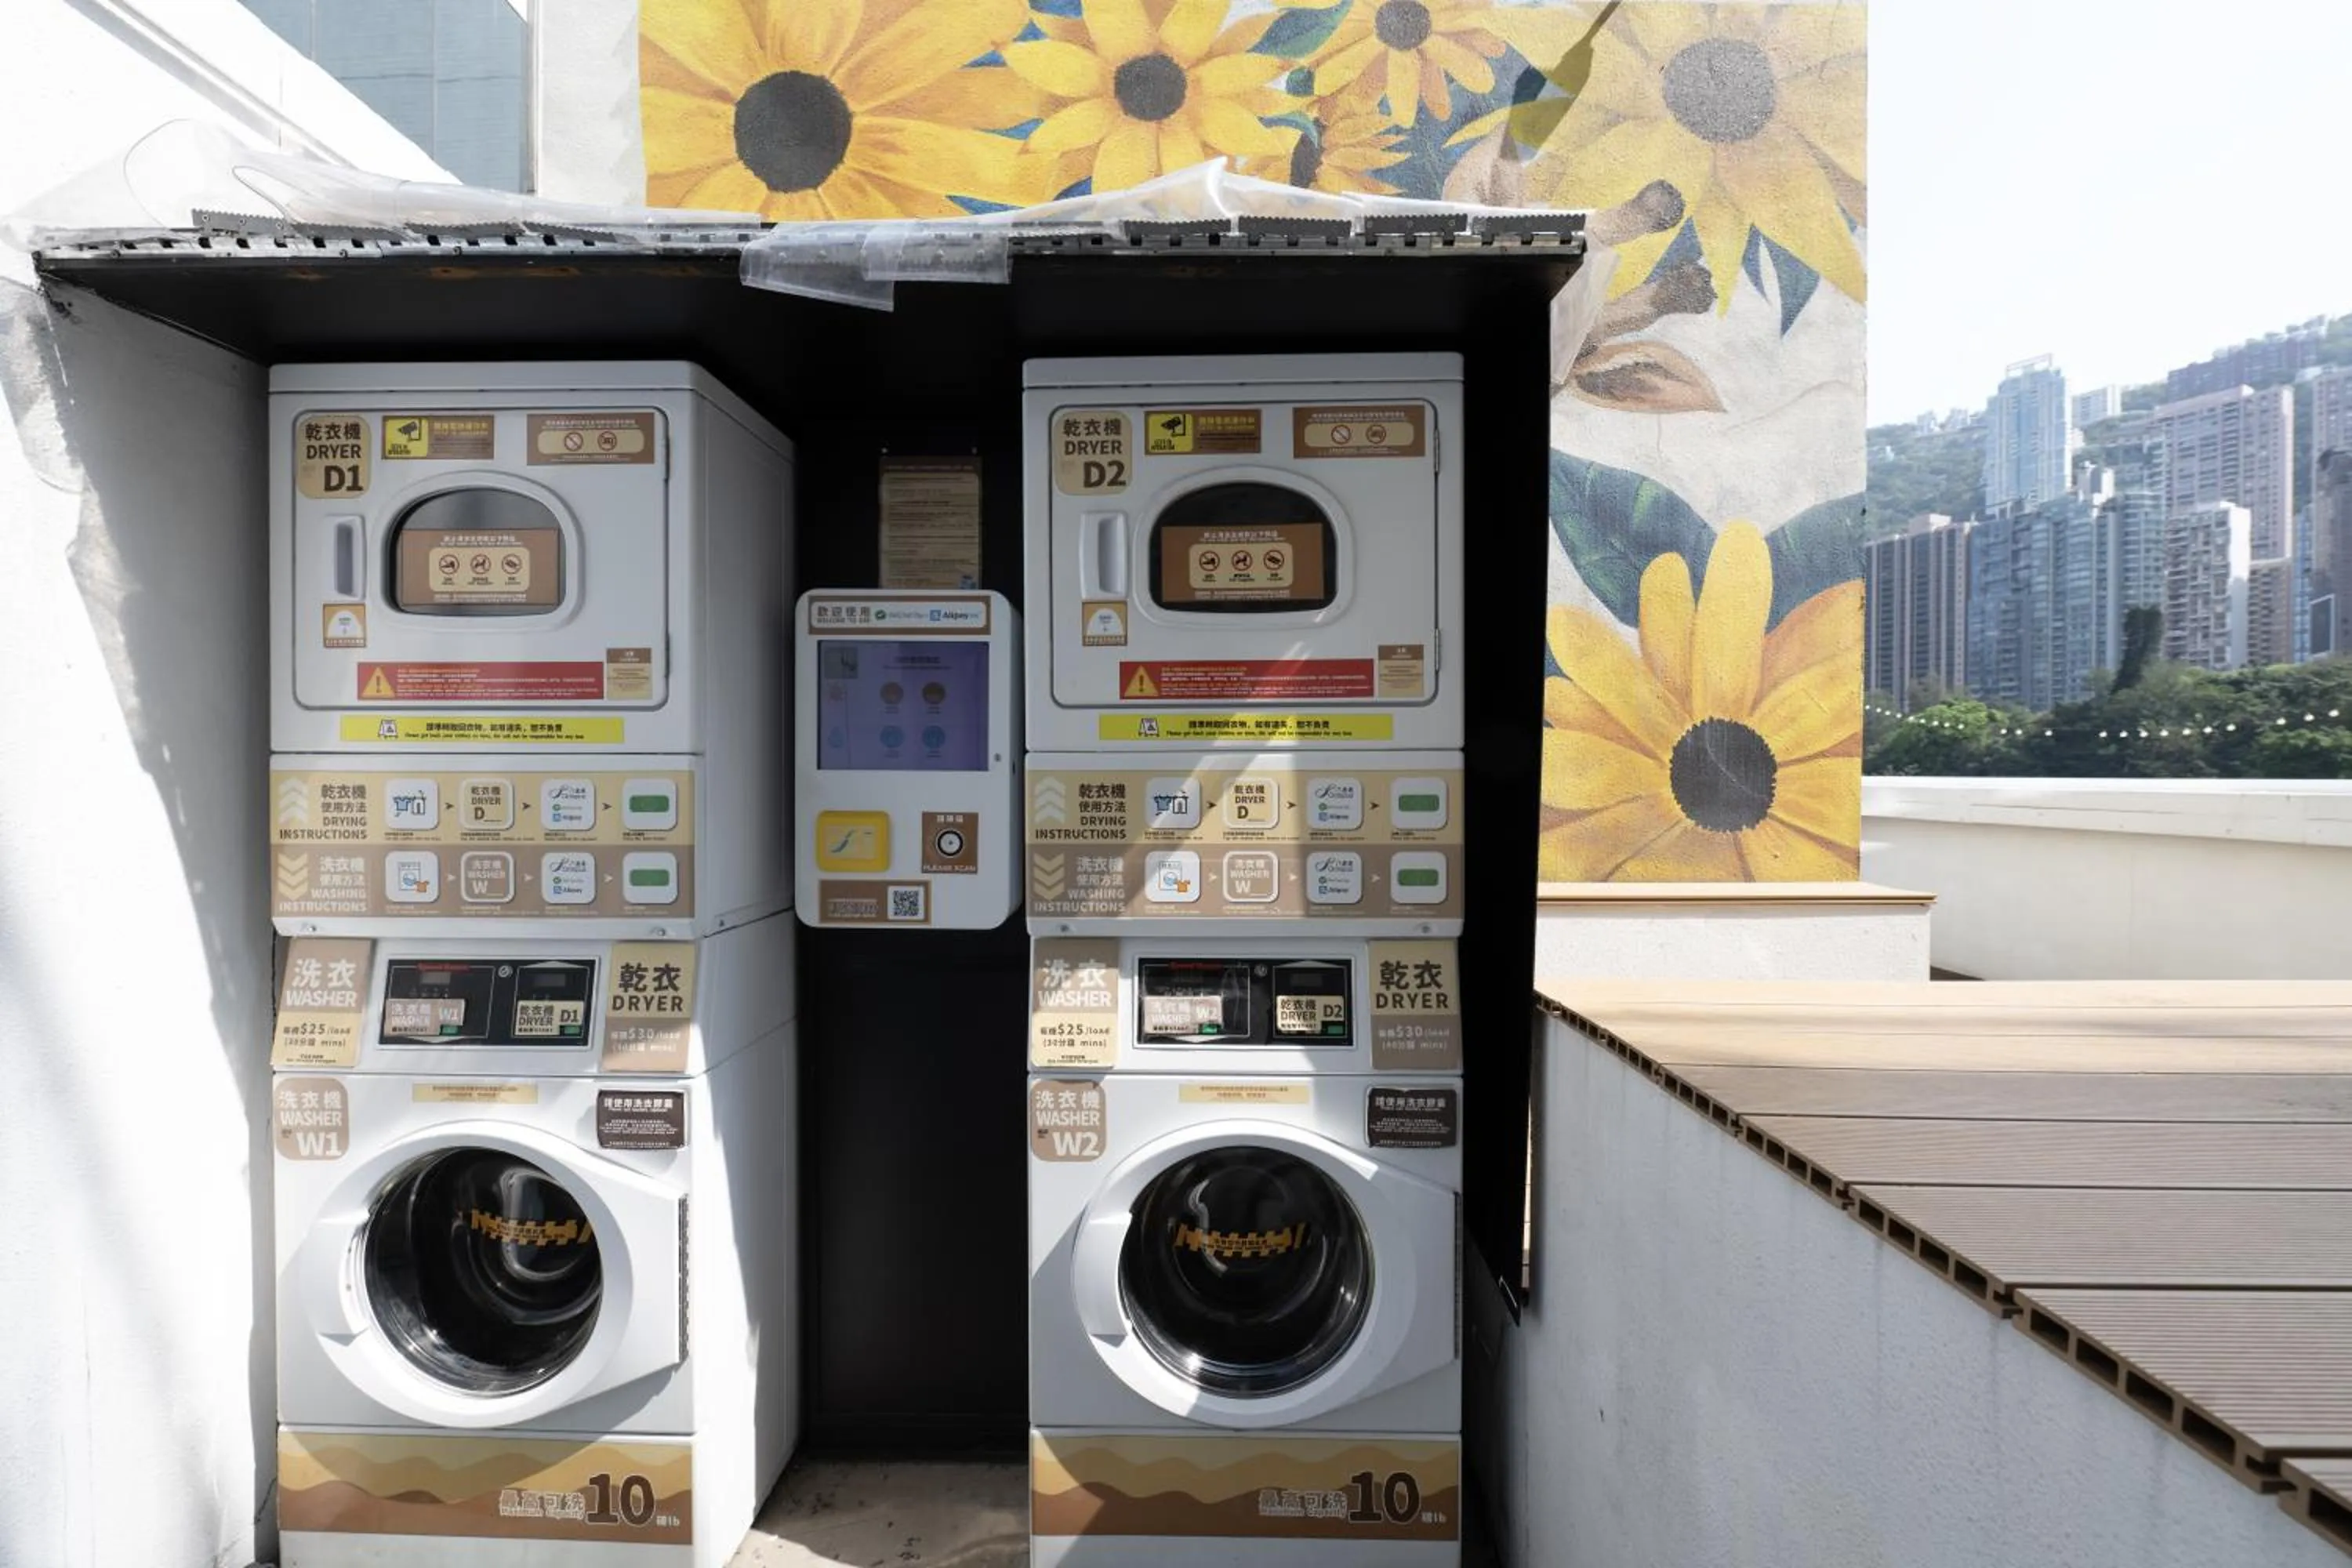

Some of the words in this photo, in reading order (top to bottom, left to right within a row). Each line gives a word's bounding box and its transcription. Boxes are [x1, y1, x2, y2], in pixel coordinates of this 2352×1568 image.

[305, 423, 361, 441] 乾衣機
[1063, 418, 1121, 437] 乾衣機
[307, 444, 361, 459] DRYER
[1064, 440, 1122, 456] DRYER
[324, 465, 364, 492] D1
[1083, 460, 1127, 488] D2
[321, 784, 366, 799] 乾衣機
[1079, 782, 1126, 799] 乾衣機
[321, 802, 367, 814] 使用方法
[1079, 801, 1127, 814] 使用方法
[1235, 796, 1265, 804] DRYER
[322, 816, 367, 827] DRYING
[1080, 816, 1127, 826] DRYING
[280, 829, 367, 840] INSTRUCTIONS
[1036, 829, 1127, 840] INSTRUCTIONS
[311, 888, 366, 899] WASHING
[1068, 888, 1125, 899] WASHING
[279, 902, 367, 913] INSTRUCTIONS
[1035, 902, 1126, 913] INSTRUCTIONS
[292, 958, 357, 989] 洗衣
[619, 963, 681, 993] 乾衣
[1041, 959, 1107, 989] 洗衣
[1380, 960, 1443, 991] 乾衣
[285, 991, 358, 1007] WASHER
[612, 996, 684, 1012] DRYER
[1038, 991, 1111, 1007] WASHER
[1280, 999, 1317, 1011] 乾衣機
[1376, 993, 1449, 1009] DRYER
[561, 1010, 579, 1022] D1
[1196, 1006, 1217, 1019] W2
[1280, 1011, 1317, 1022] DRYER
[1323, 1004, 1343, 1018] D2
[519, 1017, 553, 1026] DRYER
[280, 1091, 342, 1109] 洗衣機
[1036, 1091, 1100, 1109] 洗衣機
[281, 1111, 343, 1127] WASHER
[1036, 1110, 1100, 1127] WASHER
[296, 1131, 343, 1156] W1
[1052, 1131, 1099, 1156] W2
[586, 1472, 656, 1526] 10
[1348, 1470, 1421, 1524] 10
